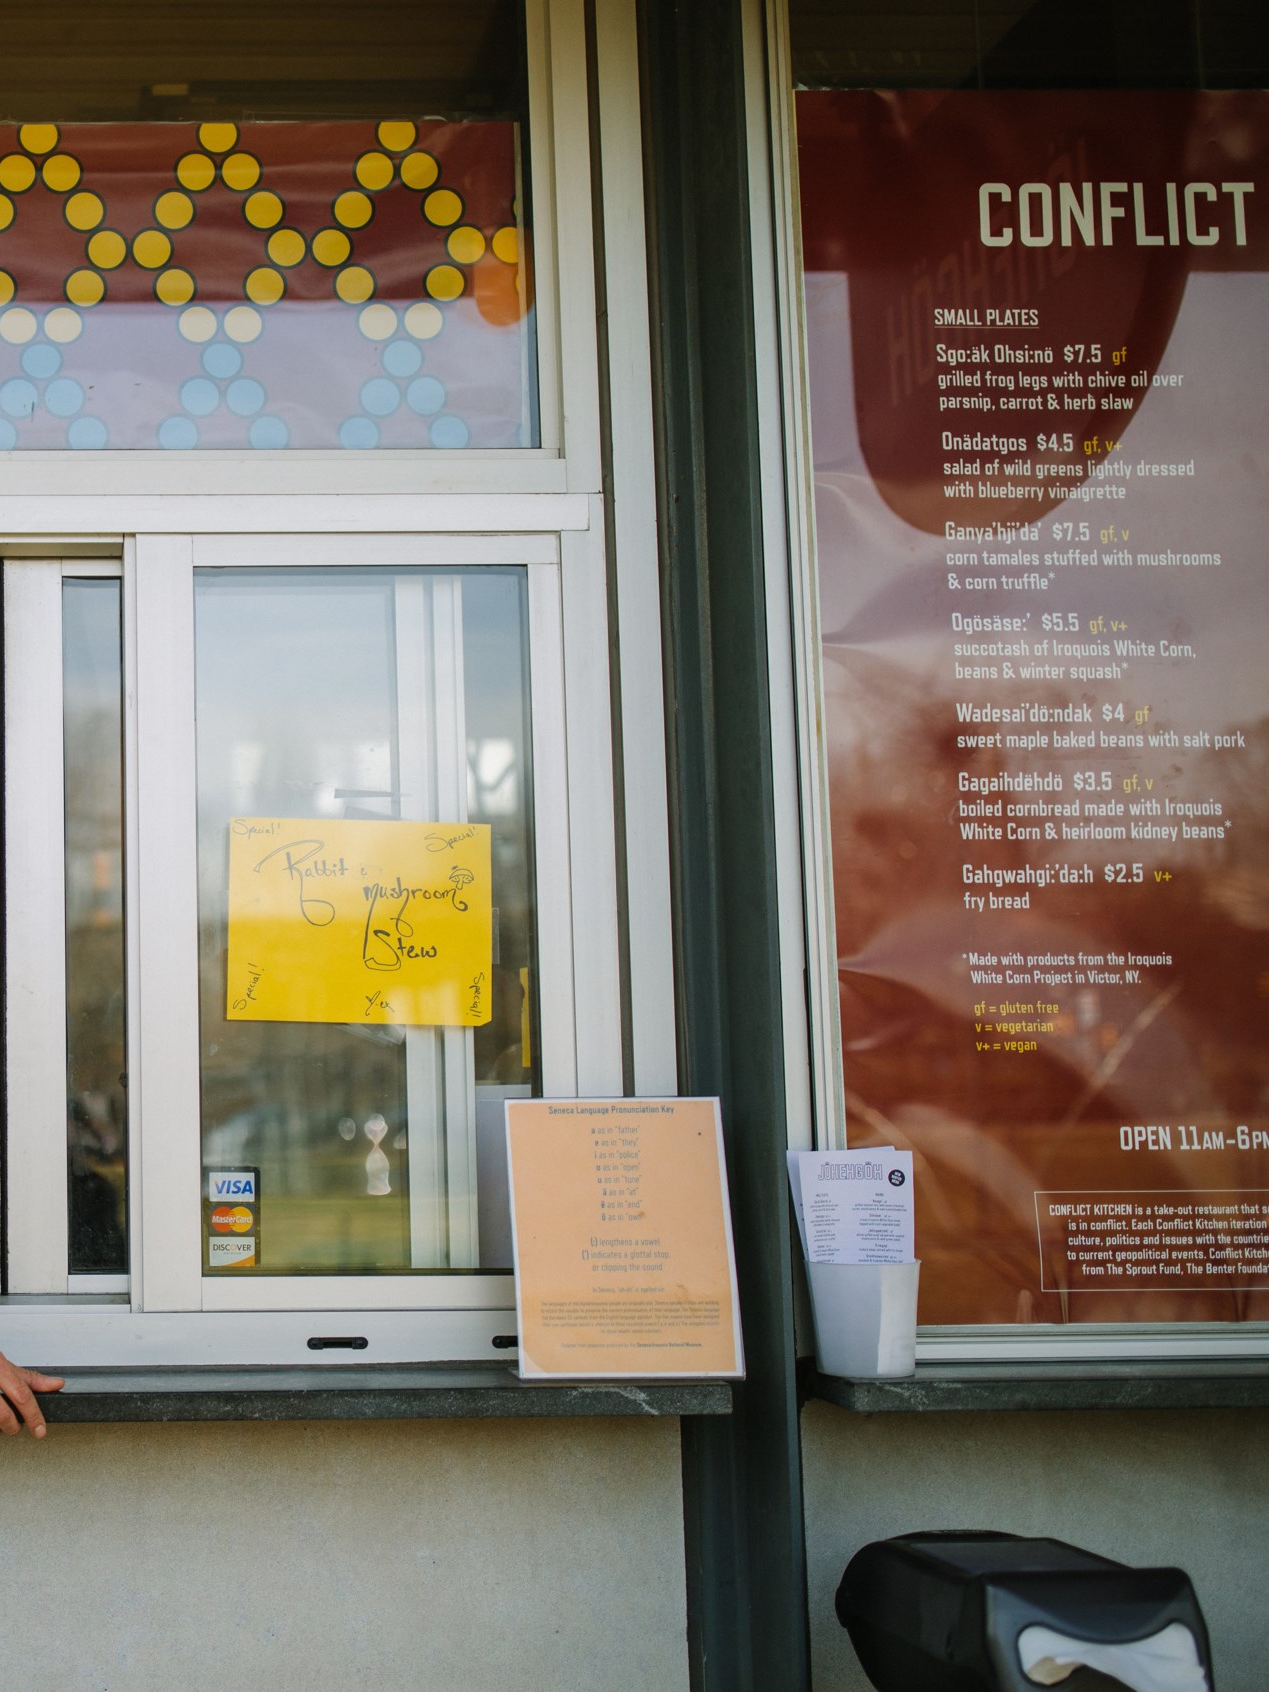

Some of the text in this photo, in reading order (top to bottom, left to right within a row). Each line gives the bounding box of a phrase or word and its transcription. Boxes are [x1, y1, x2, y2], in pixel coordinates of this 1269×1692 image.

[979, 182, 1254, 247] CONFLICT
[933, 308, 1039, 326] SMALL PLATES
[1064, 344, 1101, 363] $7.5
[1113, 347, 1126, 365] gf
[938, 370, 1183, 390] grilled frog legs with chive oil over
[940, 393, 1133, 412] parsnip, carrot & herb slaw
[942, 432, 1123, 454] Onädatgos $4.5 gf, v+
[944, 458, 1194, 479] salad of wild greens lightly dressed
[944, 481, 1125, 501] with blueberry vinaigrette
[1053, 523, 1089, 540] $7.5
[1101, 526, 1116, 543] gf,
[1122, 531, 1128, 540] v
[947, 549, 1221, 565] corn tamales stuffed with mushrooms
[948, 573, 961, 589] &
[966, 578, 997, 589] corn
[1042, 613, 1079, 631] $5.5
[1090, 616, 1106, 634] gf,
[1111, 621, 1127, 631] v+
[954, 640, 1196, 659] succotash of Iroquois White Corn,
[955, 662, 998, 679] beans
[1003, 662, 1015, 678] &
[1020, 662, 1065, 678] winter
[1103, 703, 1124, 722] $4
[1136, 706, 1149, 724] gf
[957, 731, 1245, 750] sweet maple baked beans with salt pork
[1074, 772, 1112, 790] $3.5
[1124, 775, 1140, 792] gf,
[1146, 780, 1152, 789] v
[959, 799, 1222, 818] boiled cornbread made with Iroquois
[232, 819, 280, 839] Special!
[424, 825, 480, 852] Special!
[960, 823, 1002, 839] White
[1007, 823, 1040, 839] Corn
[1045, 823, 1058, 839] &
[1063, 823, 1125, 839] heirloom
[1131, 822, 1177, 841] kidney
[1105, 864, 1143, 882] $2.5
[1154, 871, 1172, 882] v+
[964, 892, 1029, 912] fry bread
[363, 929, 438, 971] Stew
[1001, 952, 1024, 965] with
[1027, 952, 1075, 967] products
[1078, 952, 1104, 965] from
[1107, 952, 1125, 965] the
[1128, 952, 1172, 967] Iroquois
[971, 970, 1141, 986] White Corn Project in Victor, NY.
[548, 1104, 674, 1115] Seneca Language Pronunciation Key
[1120, 1126, 1171, 1150] OPEN
[214, 1179, 253, 1195] VISA
[211, 1215, 253, 1225] MasterCard
[1068, 1218, 1267, 1230] is in conflict. Each Conflict Kitchen iteration
[212, 1243, 252, 1252] DISCOVER
